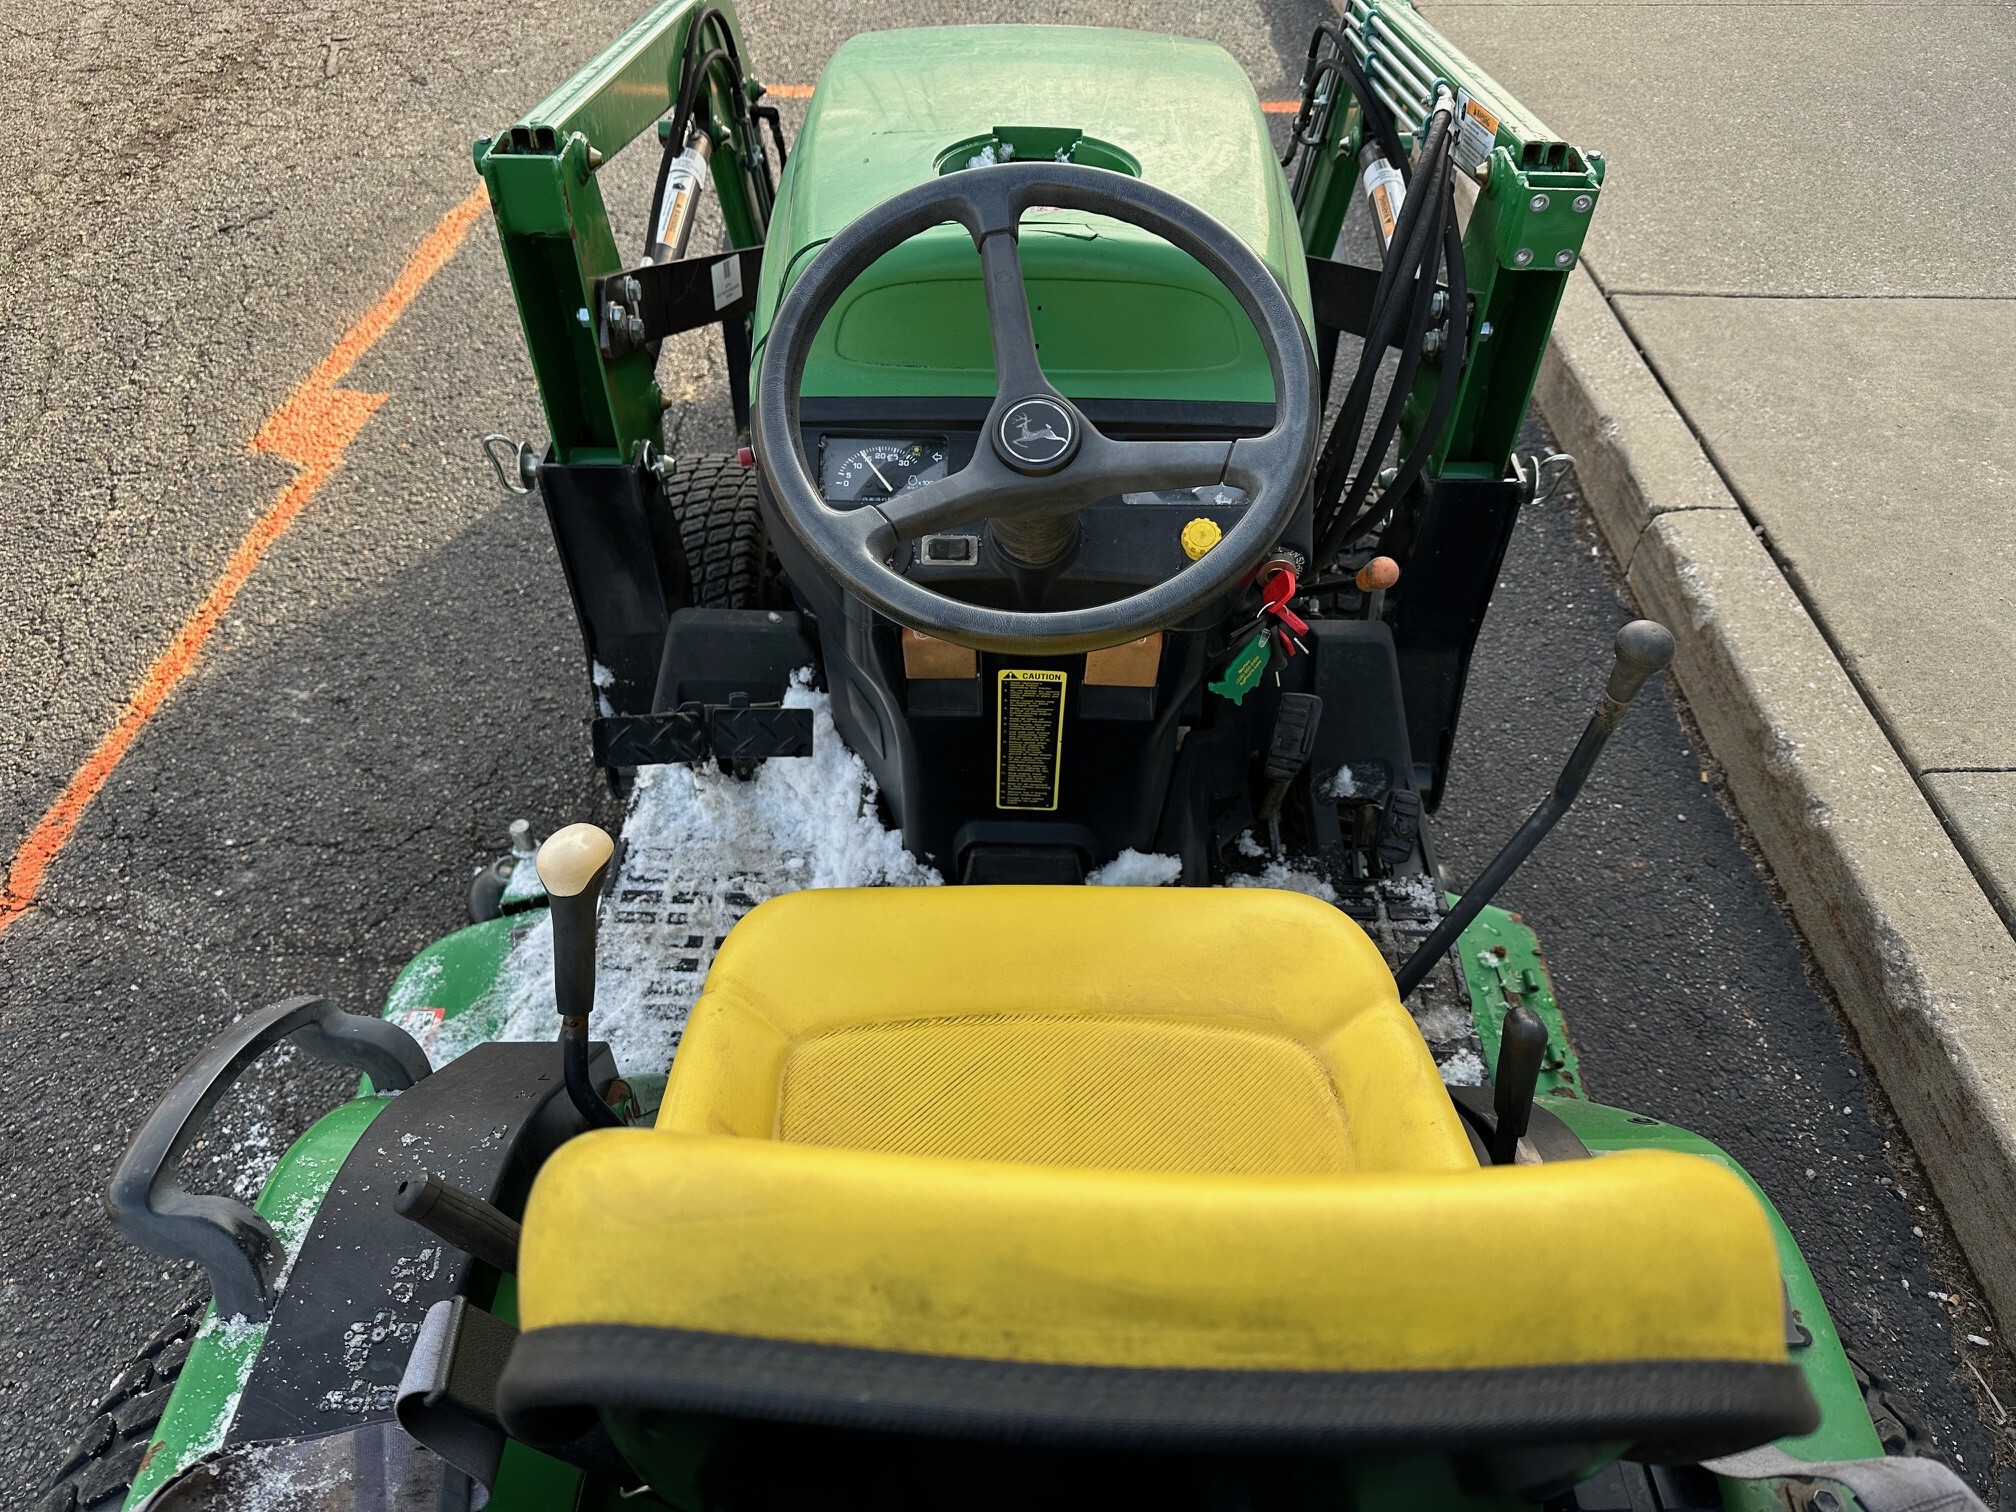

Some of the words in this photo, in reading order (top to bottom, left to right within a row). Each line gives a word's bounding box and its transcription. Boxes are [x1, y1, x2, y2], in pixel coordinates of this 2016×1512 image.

[874, 452, 886, 460] 20
[898, 459, 910, 467] 30
[1022, 672, 1062, 681] CAUTION
